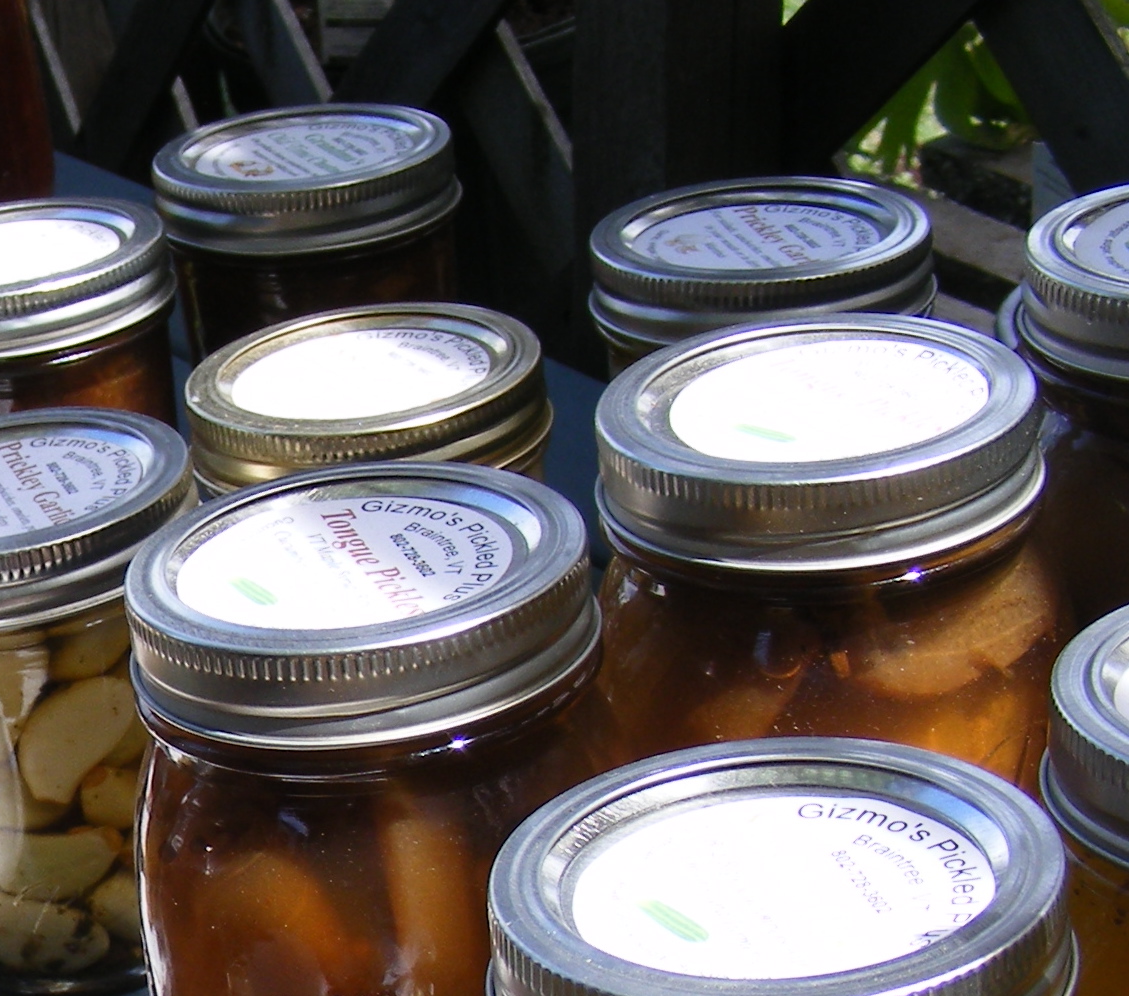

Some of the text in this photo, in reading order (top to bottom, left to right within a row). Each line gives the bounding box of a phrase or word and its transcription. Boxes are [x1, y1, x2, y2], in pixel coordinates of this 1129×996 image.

[29, 437, 111, 454] Gizmo's
[320, 508, 379, 567] Tongue
[361, 499, 500, 602] Gizmo's Pickled Plus
[403, 522, 463, 576] Braintree, VT
[796, 801, 982, 949] Gizmo's Pickled Pus
